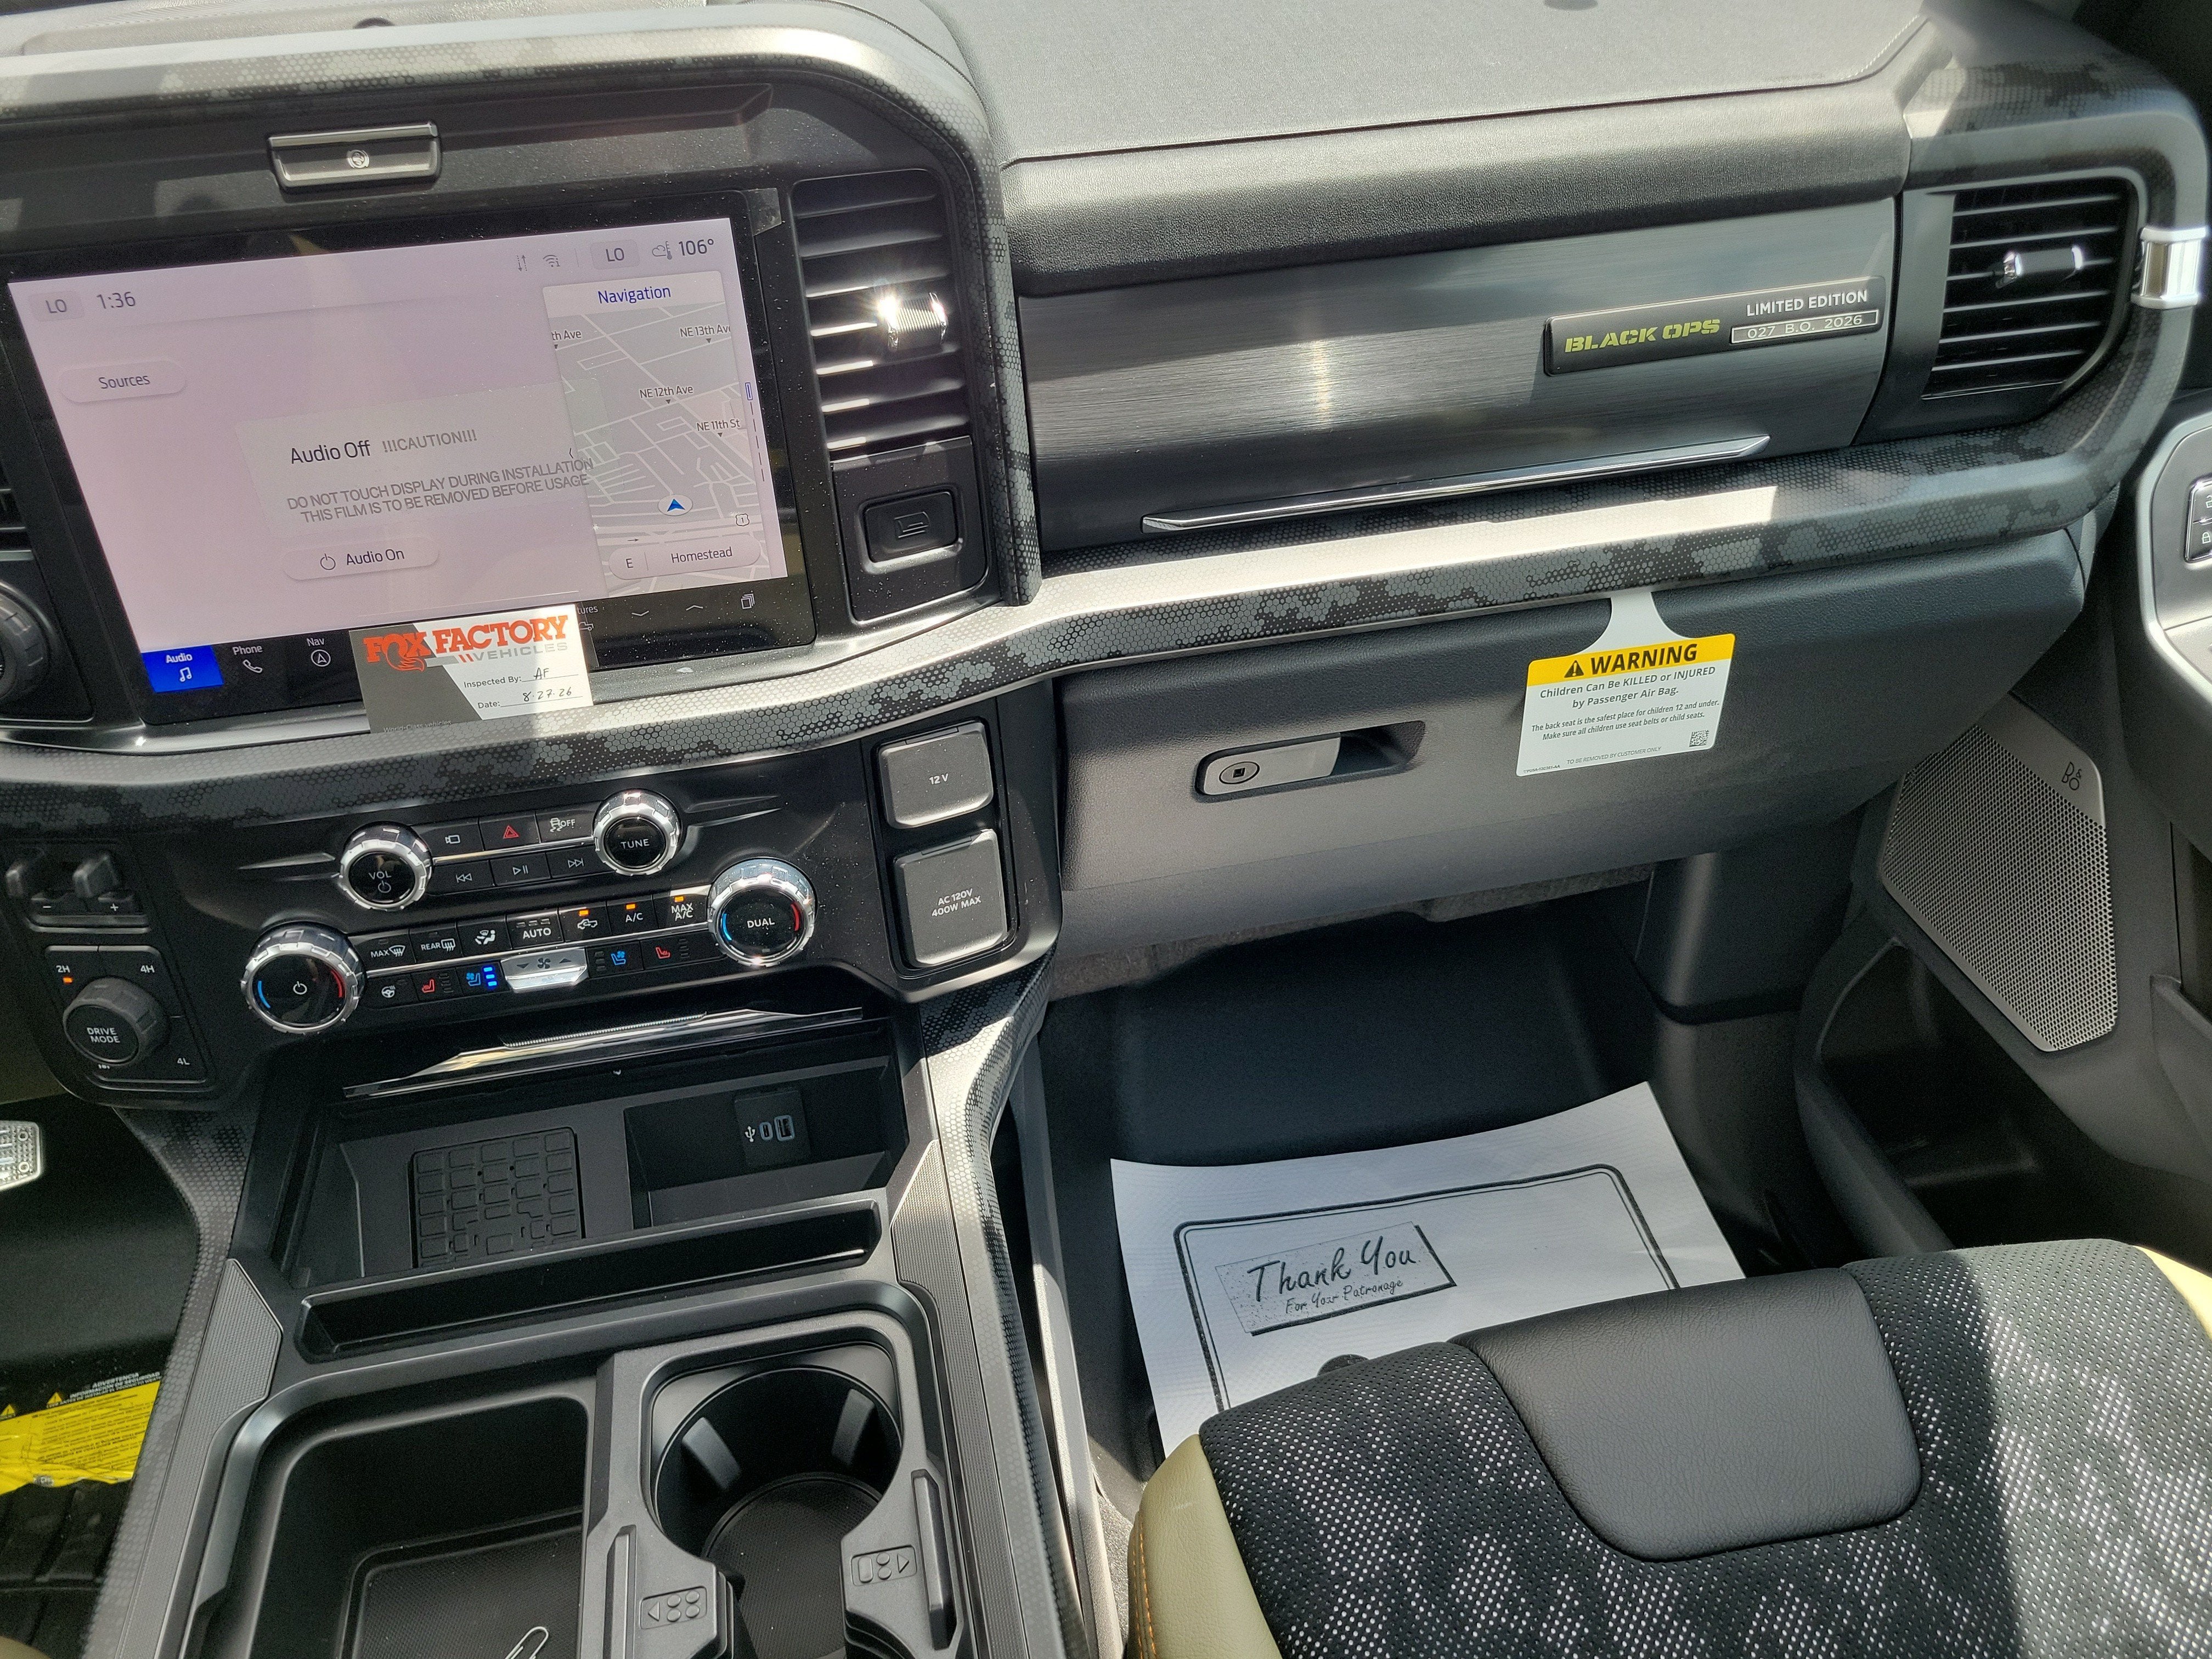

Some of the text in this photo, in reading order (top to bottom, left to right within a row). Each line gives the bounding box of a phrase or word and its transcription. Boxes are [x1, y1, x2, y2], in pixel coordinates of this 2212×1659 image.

[606, 247, 625, 262] LO
[46, 292, 136, 314] LO 1:36
[597, 285, 671, 304] Navigation
[1746, 290, 1868, 317] LIMITED EDITION
[680, 328, 693, 337] NE
[695, 325, 715, 336] 13th
[1747, 314, 1863, 338] 027 B.O. 2026
[564, 330, 582, 340] Ave
[1565, 319, 1720, 353] BLACK OPS
[98, 373, 150, 390] Sources
[640, 385, 693, 398] NE 12th Ave
[697, 419, 741, 431] NE 11th St
[382, 430, 477, 453] !!!CAUTION!!!
[291, 440, 371, 464] Audio Off
[287, 458, 594, 510] DO NOT TOUCH DISPLAY DURING INSTALLATION
[301, 473, 589, 523] THIS FILM IS TO BE REMOVED BEFORE USAGE
[346, 548, 405, 566] Audio On
[626, 558, 633, 568] E
[670, 546, 733, 563] Homestead
[233, 644, 263, 656] Phone
[307, 637, 324, 647] Nav
[363, 615, 568, 672] FOX FACTORY
[166, 653, 193, 664] Audio
[473, 642, 568, 661] VEHICLES
[1591, 644, 1697, 675] WARNING
[464, 675, 522, 689] Inspected By:
[1540, 667, 1716, 698] Children Can Be KILLED or INJURED
[477, 700, 501, 709] Date:
[1572, 687, 1679, 709] by Passenger Air Bag.
[1545, 721, 1560, 730] back
[1596, 714, 1616, 723] safest
[1617, 710, 1634, 721] place
[1647, 706, 1673, 715] children
[1684, 702, 1697, 710] and
[1699, 699, 1719, 708] under.
[1543, 732, 1561, 741] Make
[1588, 725, 1613, 733] children
[1643, 718, 1659, 726] belts
[1669, 713, 1685, 722] child
[1583, 754, 1609, 763] REMOVED
[1617, 749, 1646, 757] CUSTOMER
[561, 819, 575, 827] OFF
[620, 838, 650, 848] TUNE
[369, 871, 391, 879] VOL
[938, 888, 973, 906] AC 120V
[671, 903, 693, 915] MAX
[932, 895, 981, 917] 400W MAX
[625, 912, 644, 923] A/C
[675, 910, 693, 921] A/C
[747, 917, 775, 928] DUAL
[522, 928, 551, 939] AUTO
[371, 950, 390, 958] MAX
[421, 943, 440, 951] REAR
[1247, 1235, 1420, 1302] Thank You
[1285, 1279, 1403, 1314] For Your Patronage
